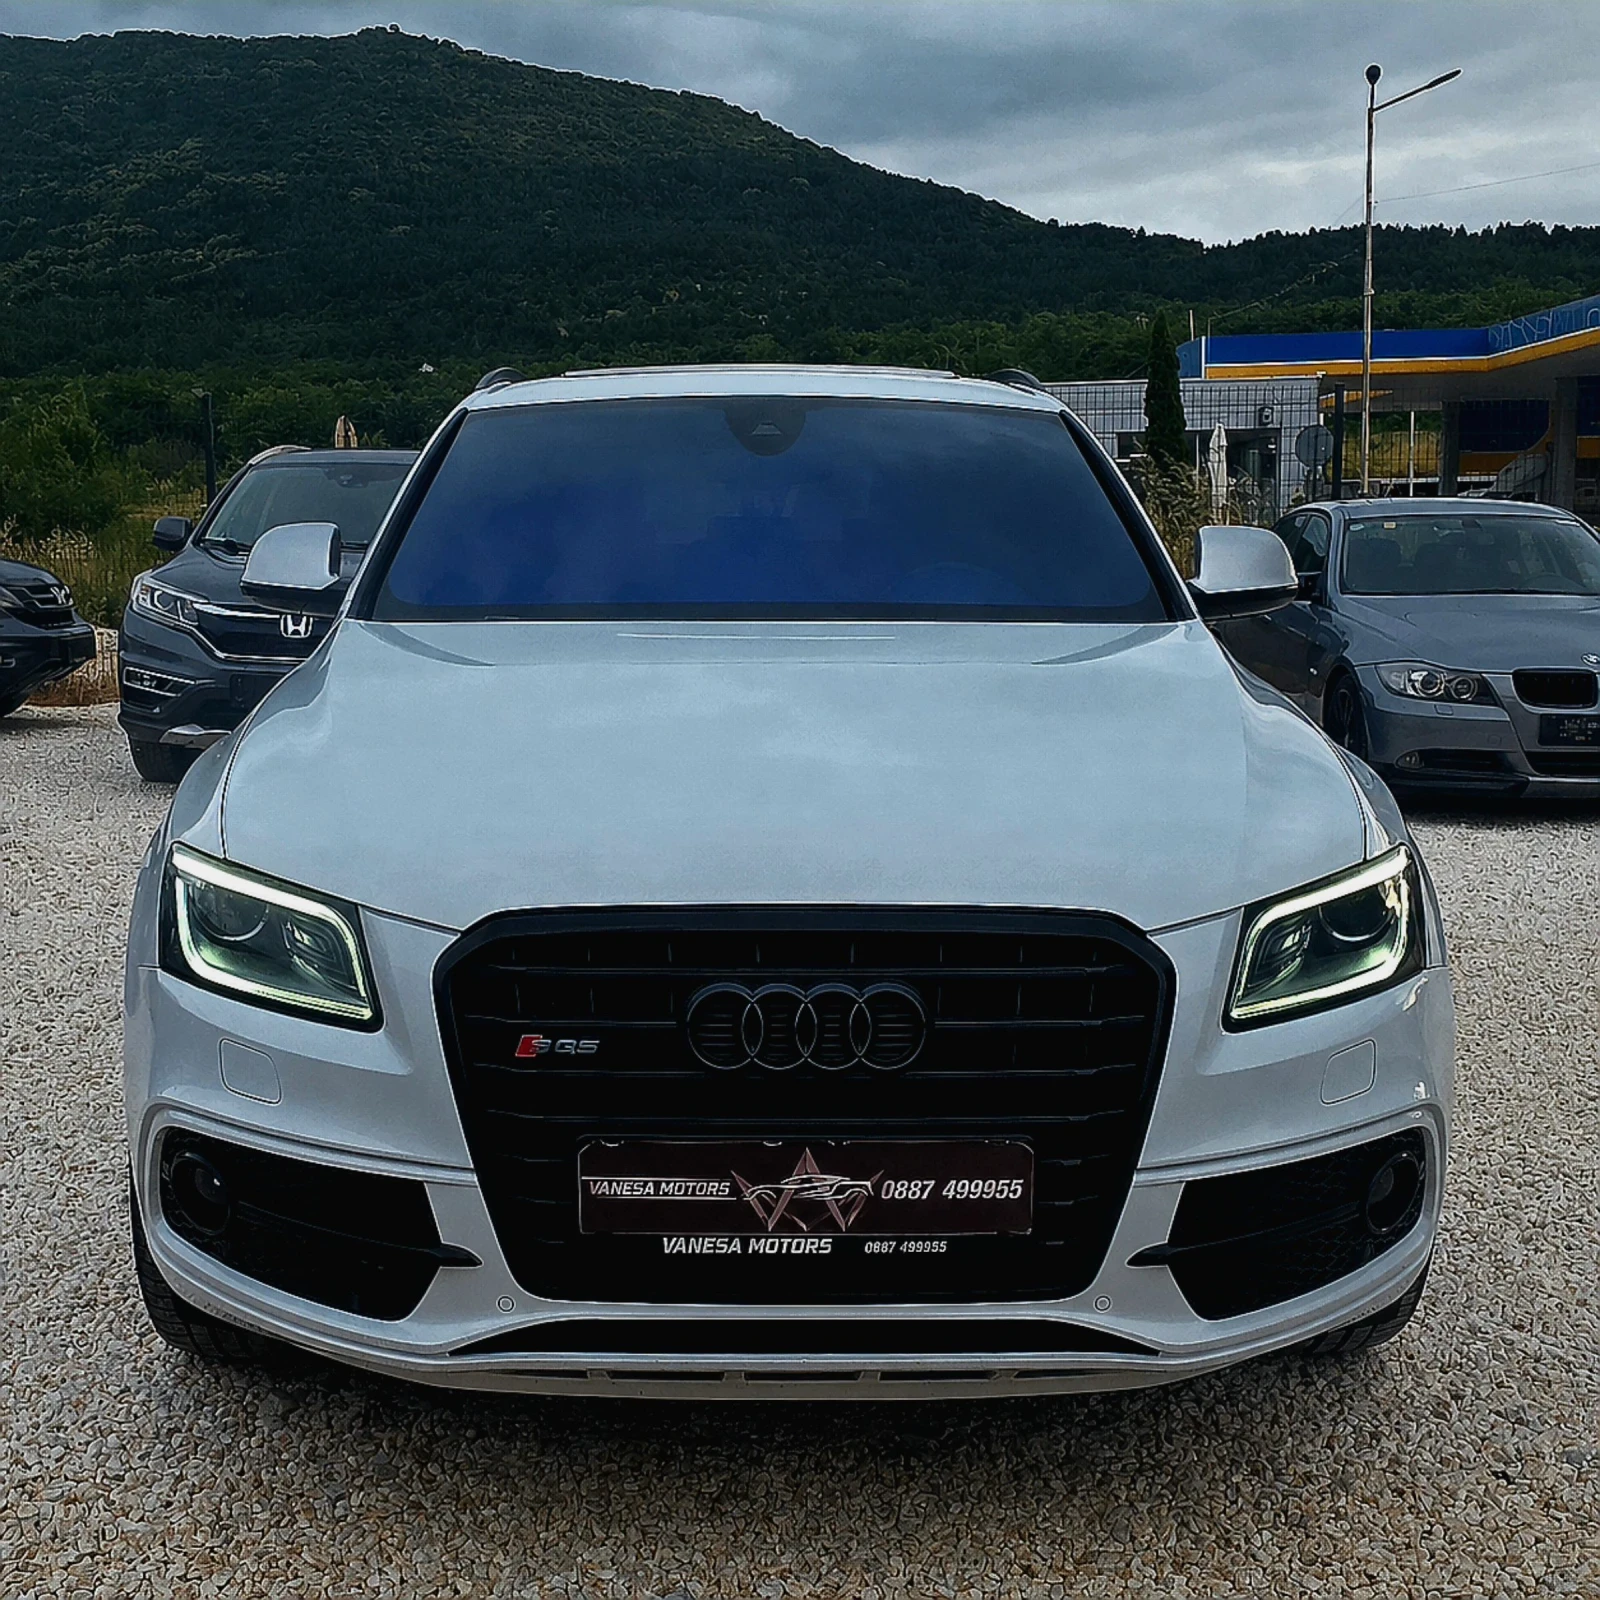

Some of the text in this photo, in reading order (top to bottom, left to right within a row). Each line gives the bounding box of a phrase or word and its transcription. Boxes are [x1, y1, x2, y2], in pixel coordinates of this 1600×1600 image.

[589, 1179, 1024, 1200] VANESA MOTORS 0887 499955
[662, 1236, 948, 1255] VANESA MOTORS 0887 499955
